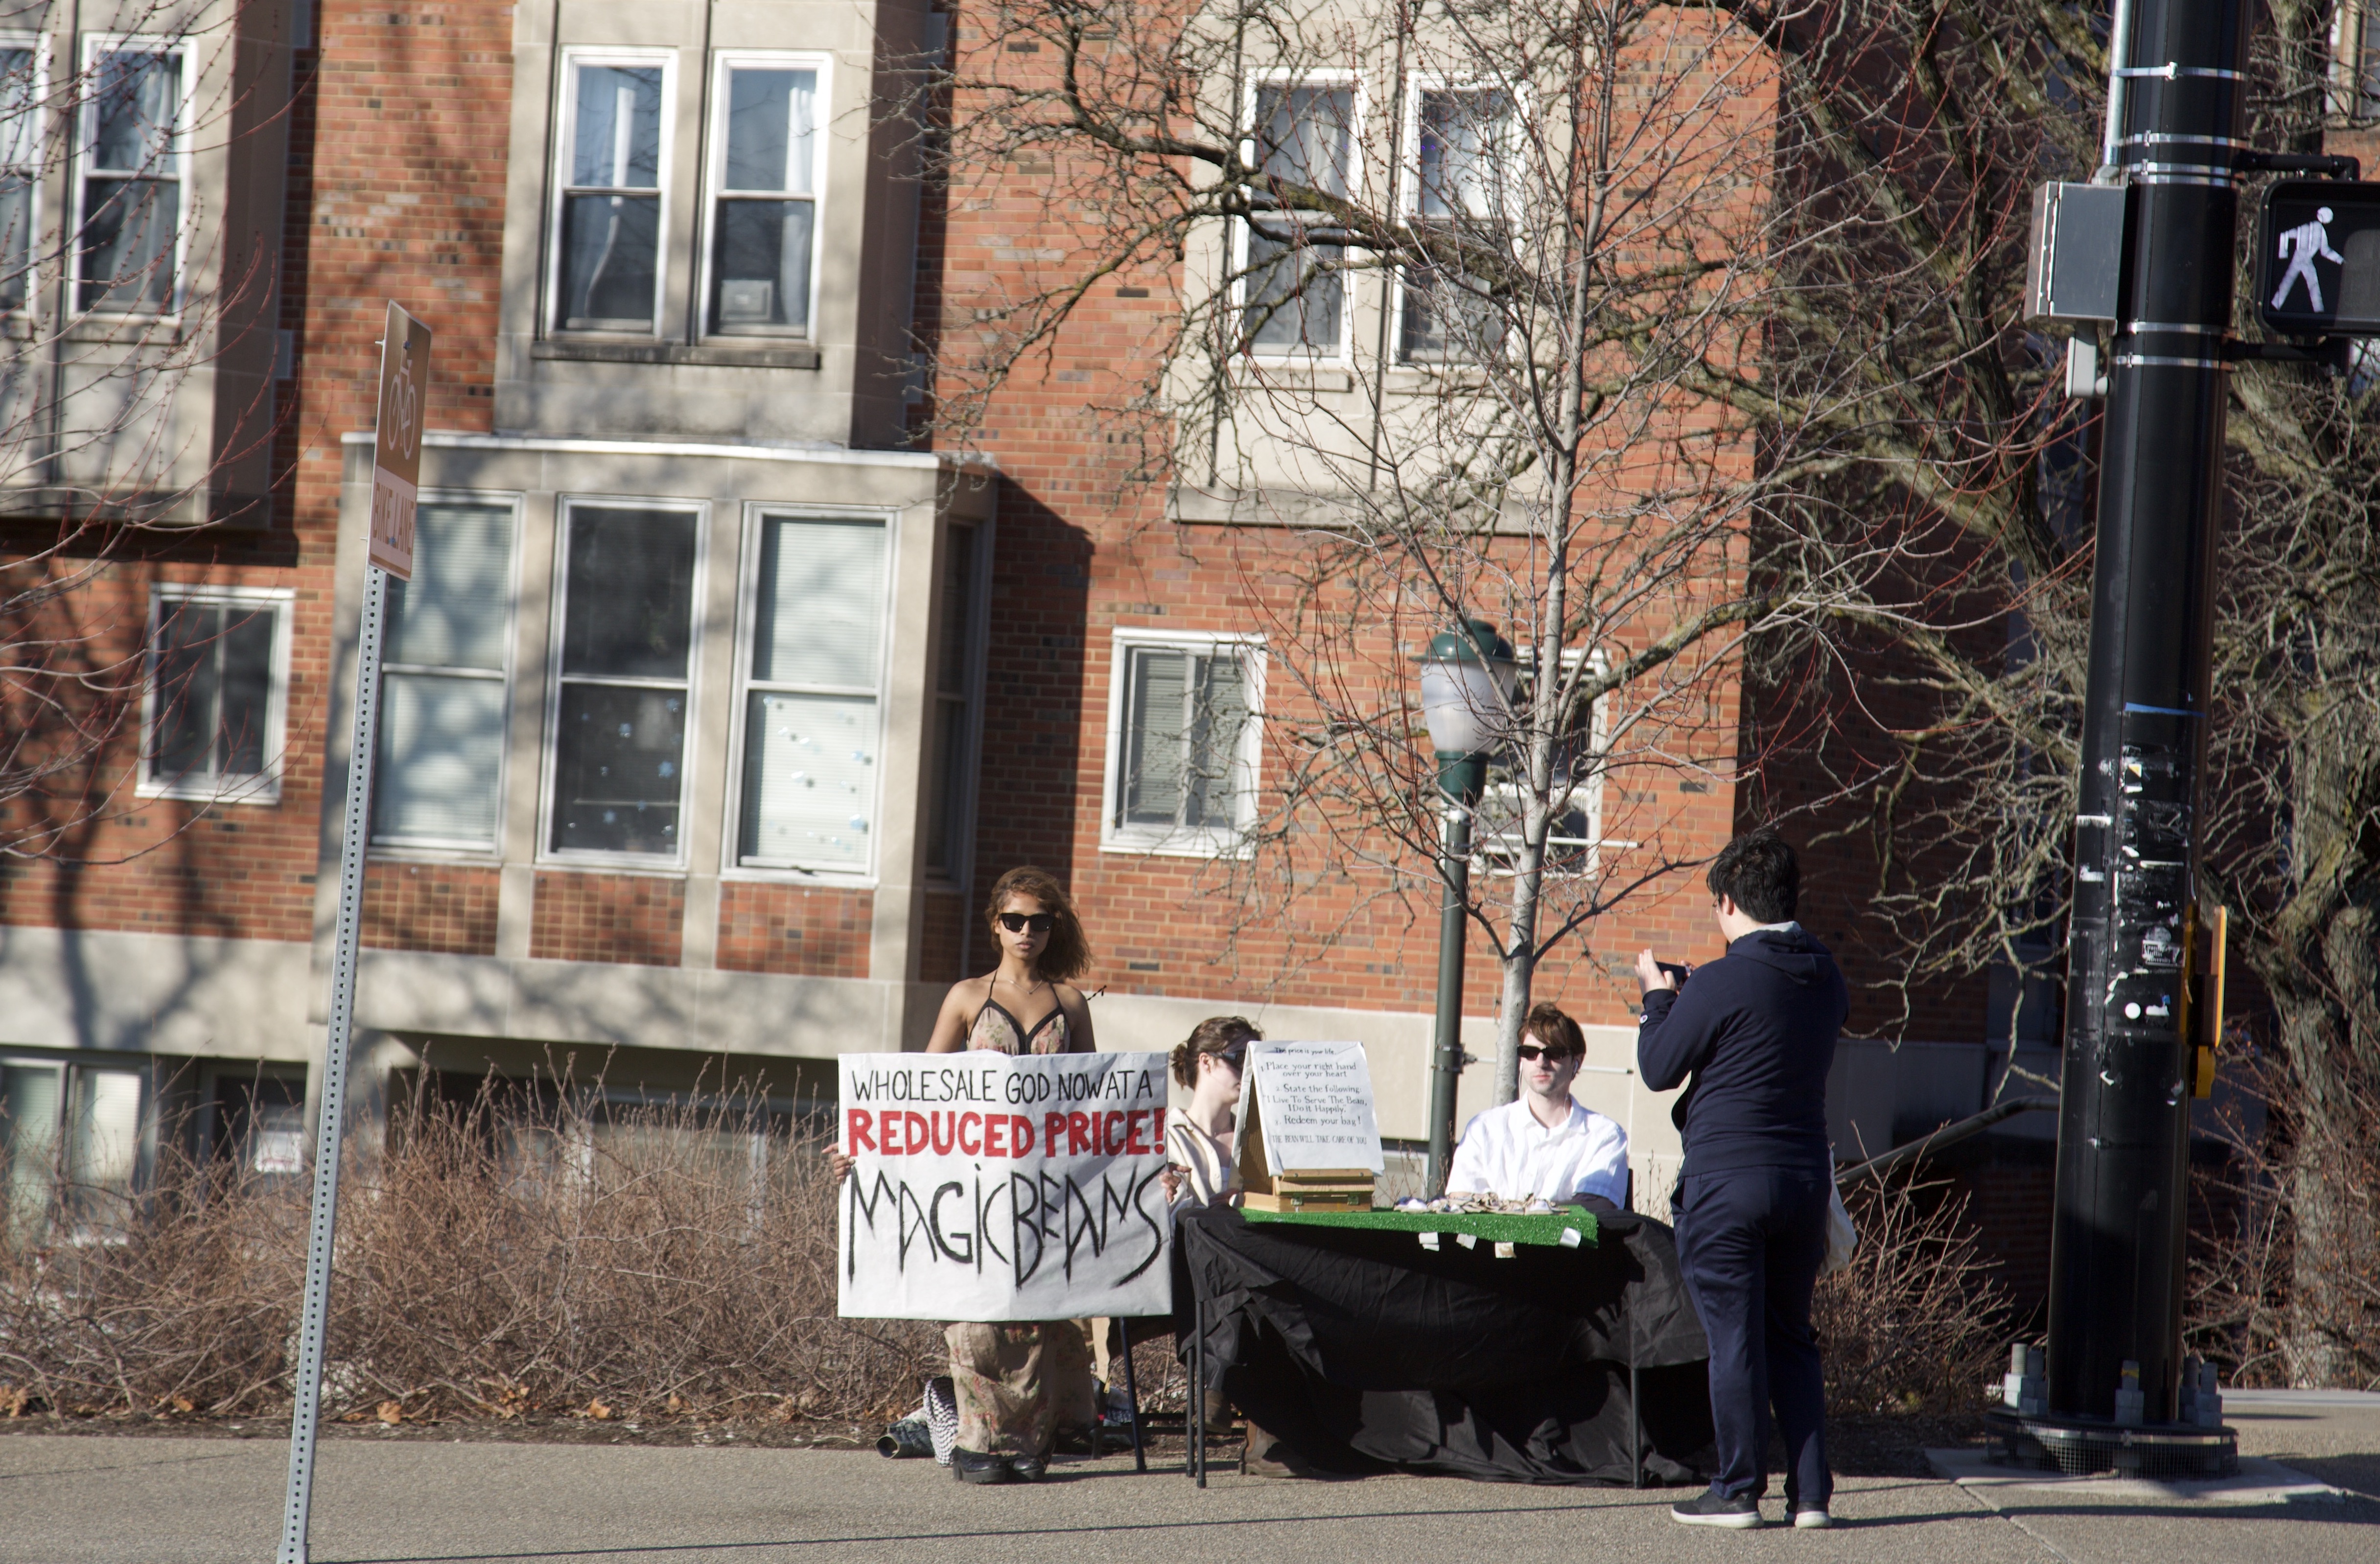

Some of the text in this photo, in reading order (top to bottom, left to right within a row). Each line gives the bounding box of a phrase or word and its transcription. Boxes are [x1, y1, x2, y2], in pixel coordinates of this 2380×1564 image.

[373, 482, 414, 555] BIKE LANE
[1266, 1061, 1289, 1070] Place
[1314, 1062, 1333, 1071] right
[1336, 1062, 1356, 1070] hand
[852, 1069, 997, 1102] WHOLESALE
[1005, 1072, 1050, 1104] GOD
[1283, 1083, 1307, 1093] State
[1290, 1095, 1302, 1104] To
[1304, 1095, 1326, 1104] Serve
[1328, 1095, 1344, 1104] The
[1346, 1096, 1367, 1106] Bean,
[1284, 1115, 1317, 1125] Redeem
[848, 1107, 1166, 1159] REDUCED PRICE!
[1272, 1134, 1367, 1145] THE BEAN WILL TAKE CARE OF YOU
[1011, 1162, 1167, 1295] BEANS
